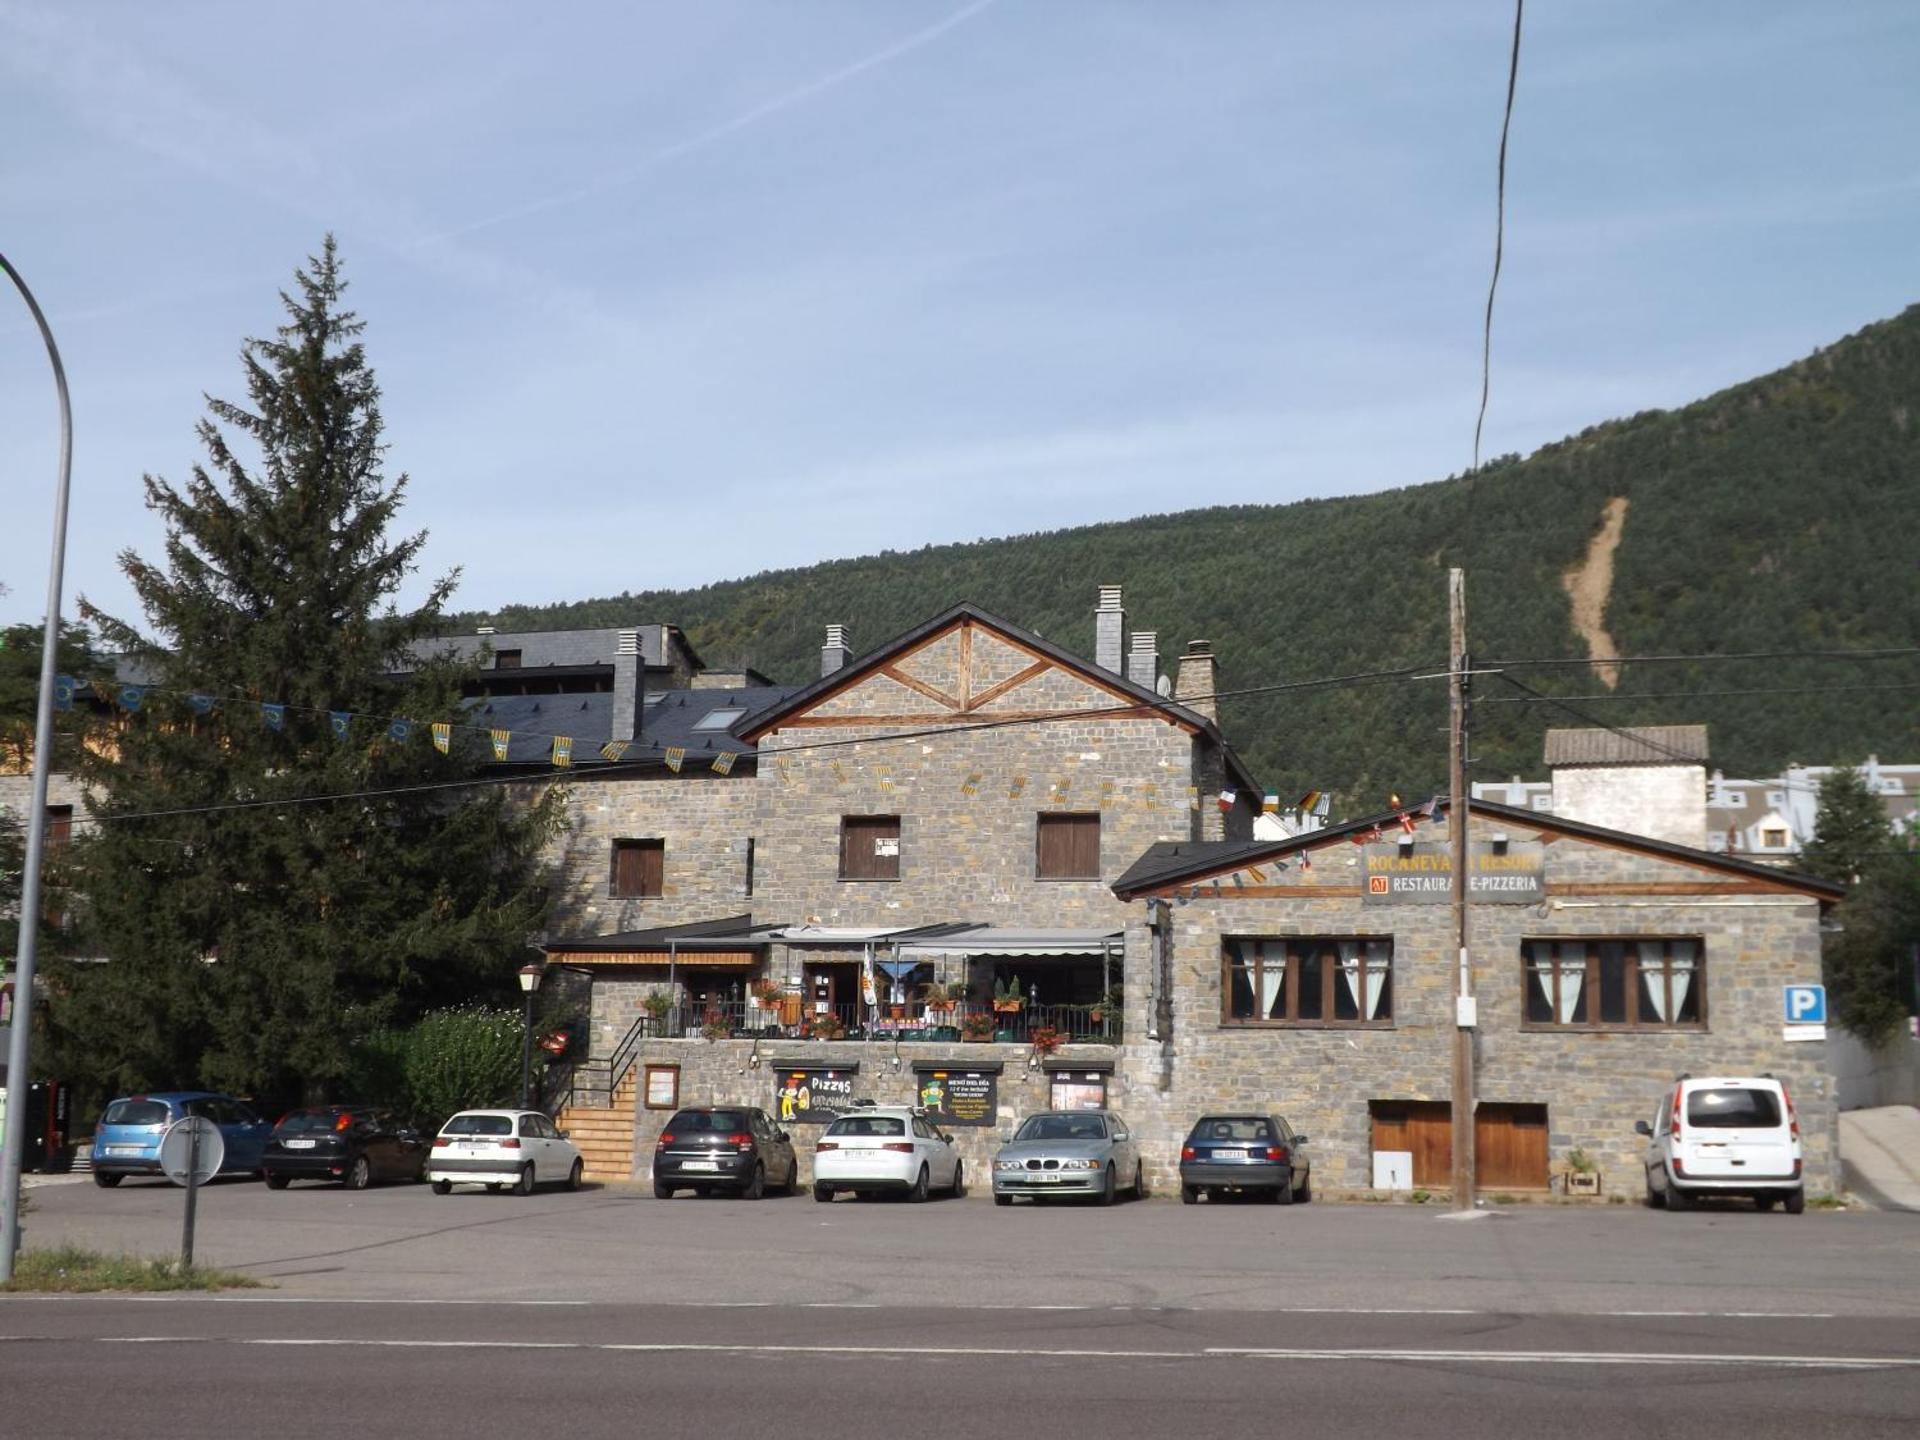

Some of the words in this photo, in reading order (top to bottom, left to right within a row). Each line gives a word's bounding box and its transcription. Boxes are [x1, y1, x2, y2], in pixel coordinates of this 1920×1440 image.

[1368, 855, 1475, 871] ROCANEVA
[1393, 877, 1537, 891] RESTAURAE-PIZZERIA
[1792, 990, 1816, 1019] P
